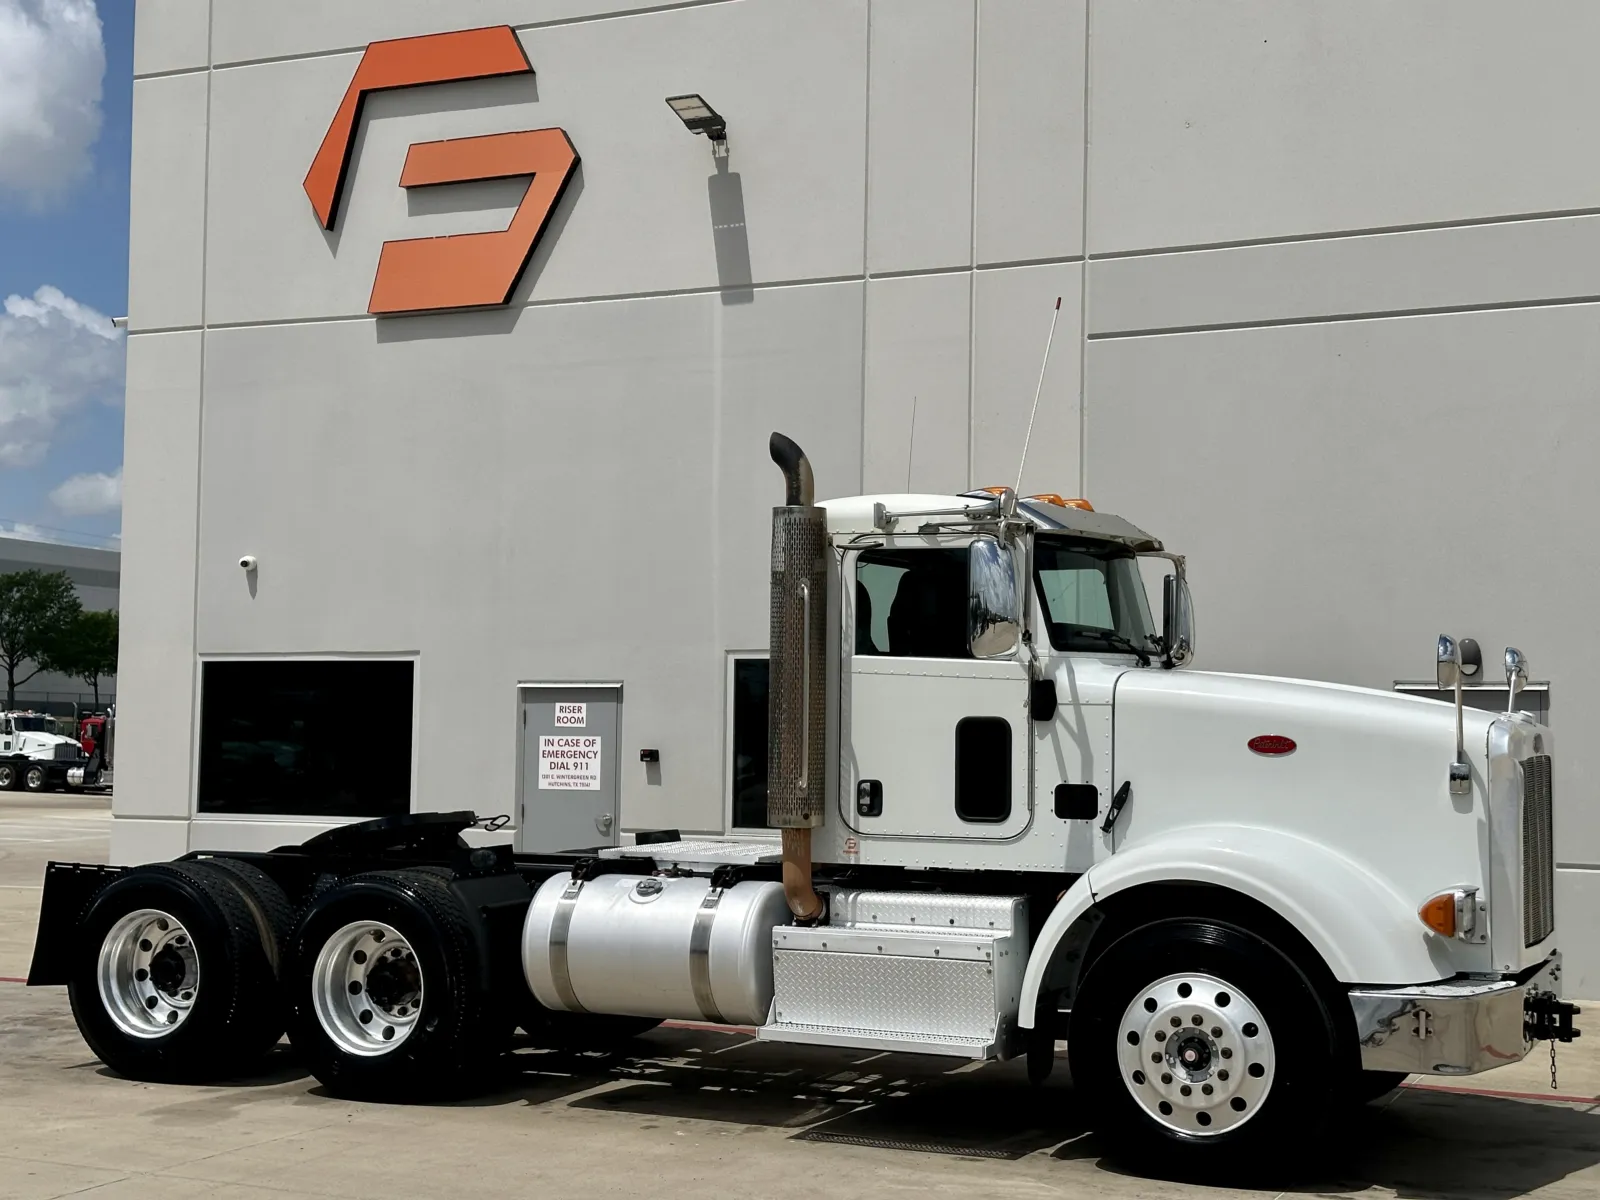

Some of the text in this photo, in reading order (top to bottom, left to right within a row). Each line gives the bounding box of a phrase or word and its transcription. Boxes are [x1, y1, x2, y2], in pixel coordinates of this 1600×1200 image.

[559, 705, 582, 714] RISER
[556, 716, 584, 724] ROOM
[544, 738, 597, 747] IN CASE OF
[542, 749, 598, 759] EMERGENCY
[549, 761, 589, 770] DIAL 911
